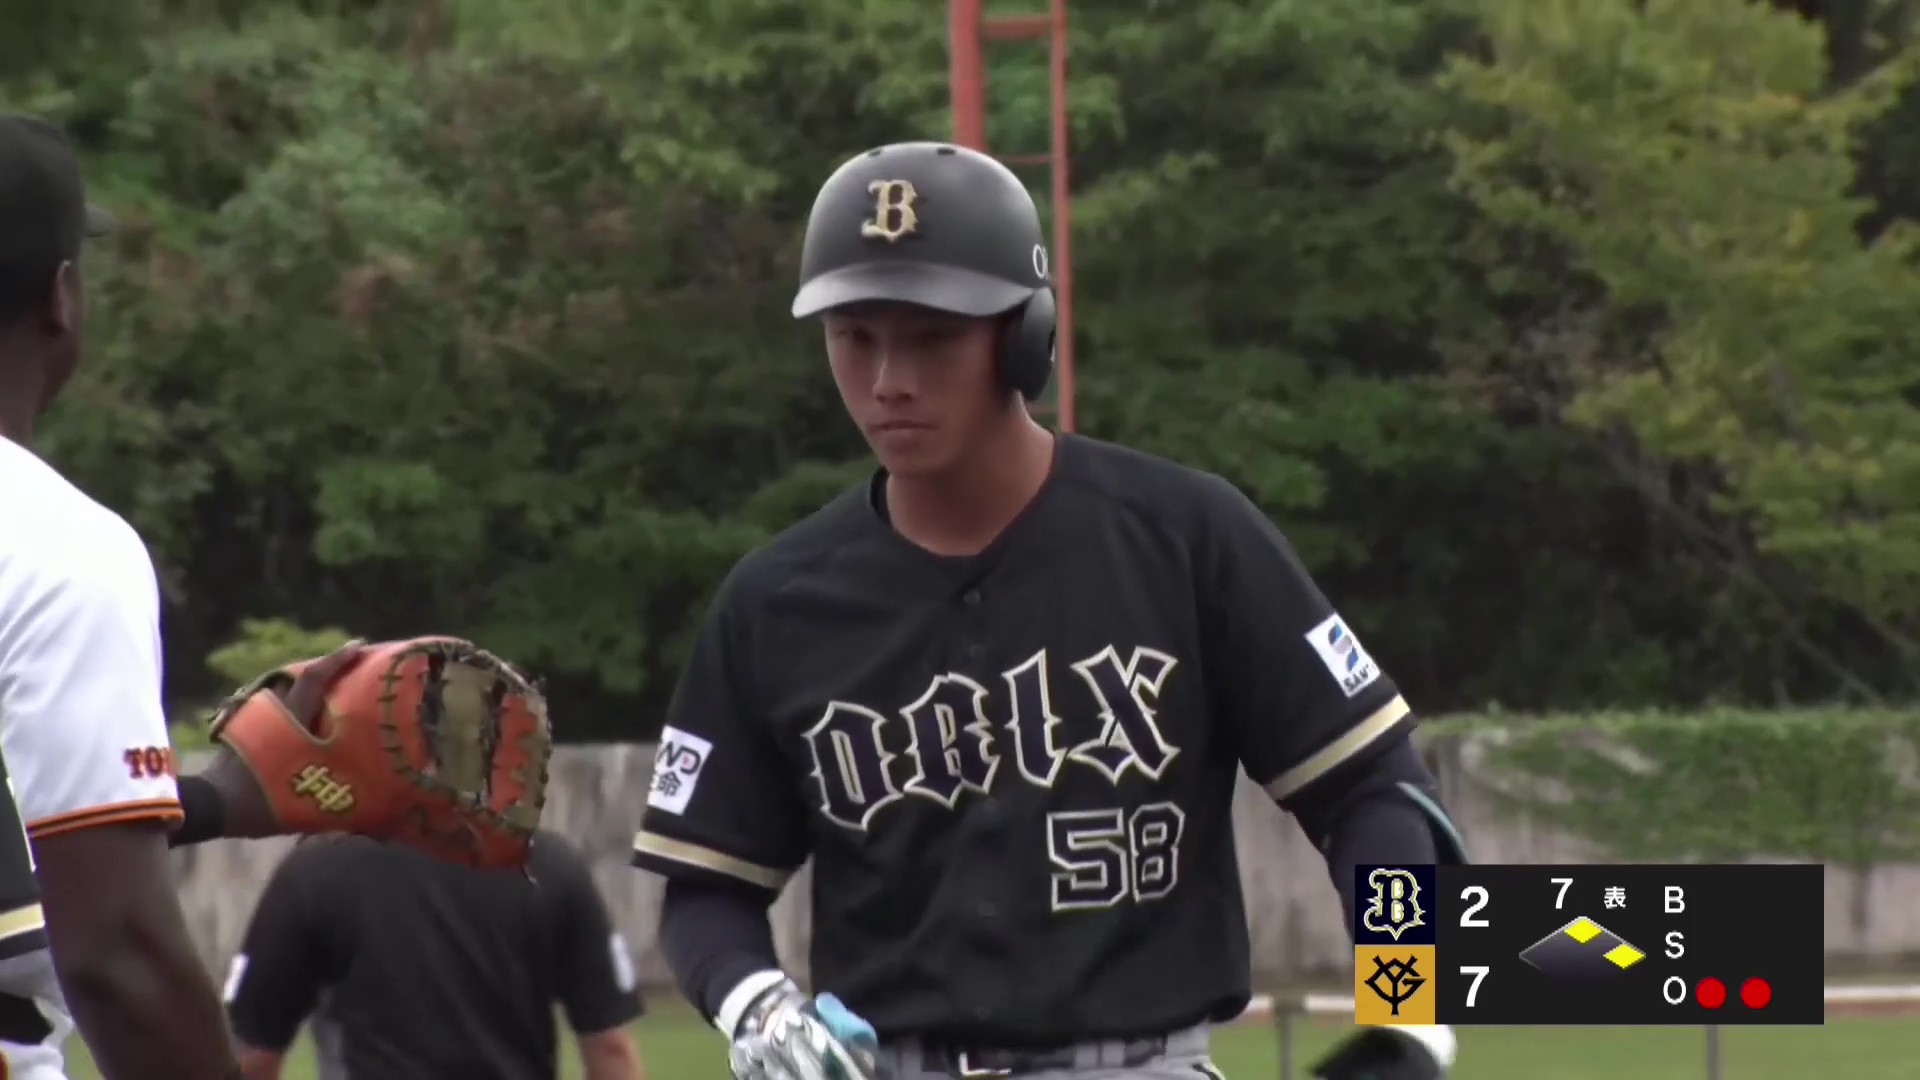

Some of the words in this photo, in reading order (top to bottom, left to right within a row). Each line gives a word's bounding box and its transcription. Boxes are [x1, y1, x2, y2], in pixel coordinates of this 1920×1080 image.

[861, 179, 919, 243] B
[801, 644, 1182, 831] ORIX
[1046, 801, 1185, 912] 58
